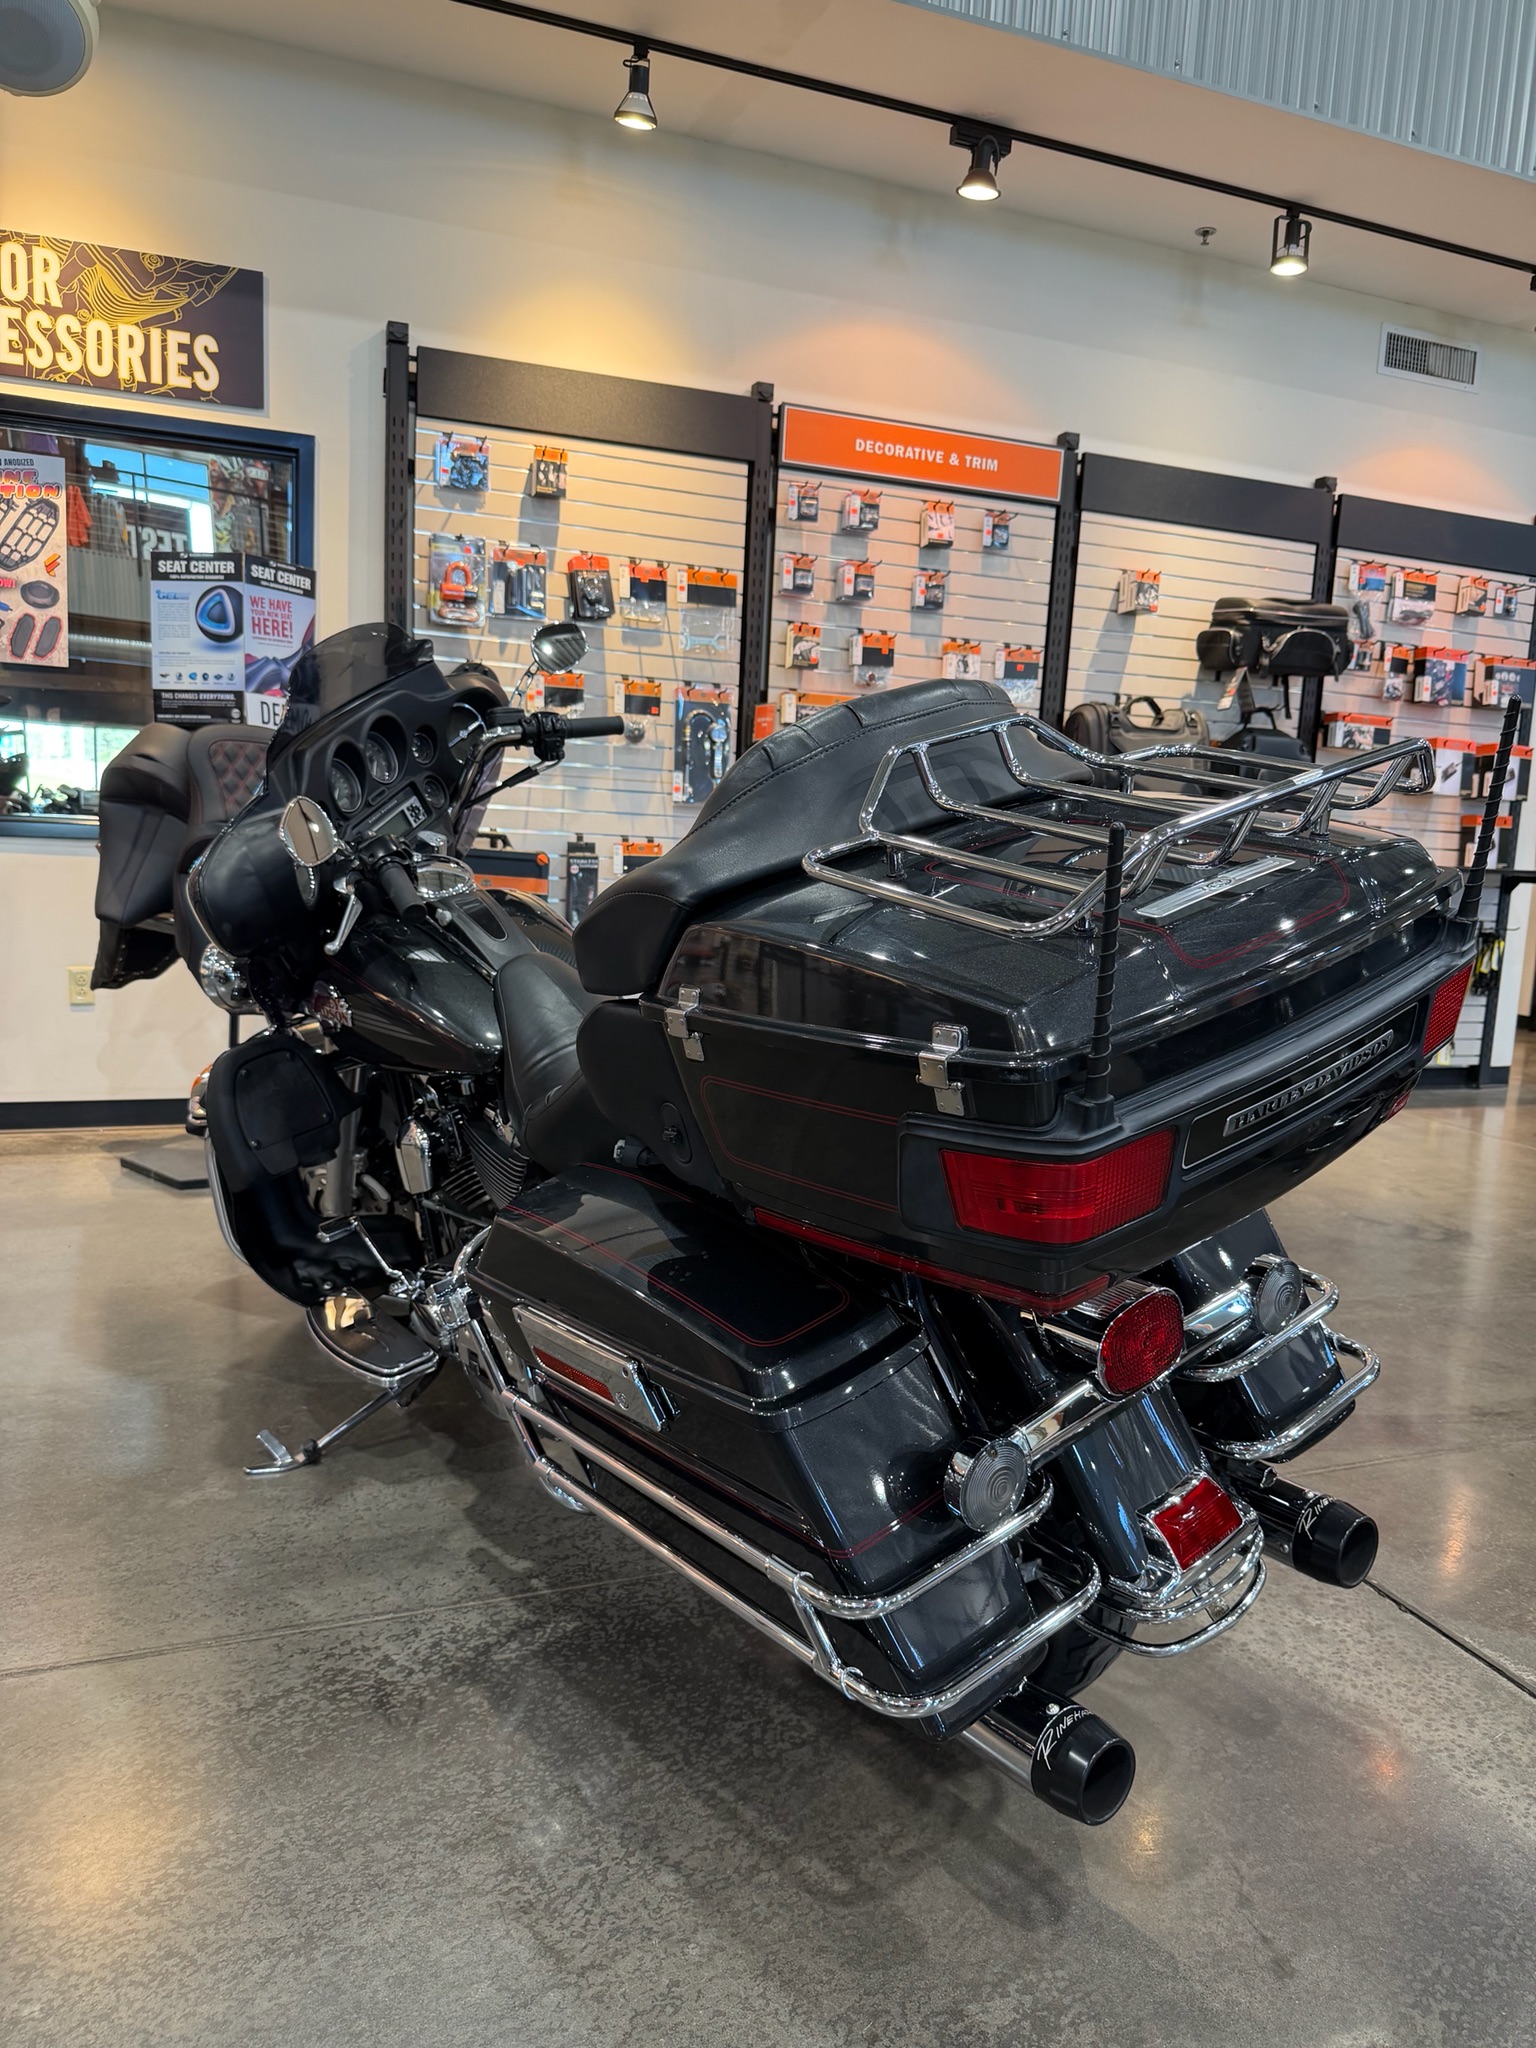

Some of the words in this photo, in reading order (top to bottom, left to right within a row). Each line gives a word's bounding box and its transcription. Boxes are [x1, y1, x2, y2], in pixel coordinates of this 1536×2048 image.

[0, 241, 63, 307] OR
[0, 305, 220, 393] ESSORIES
[4, 458, 34, 467] ANODIZED
[855, 438, 944, 464] DECORATIVE
[948, 452, 960, 467] &
[965, 454, 998, 472] TRIM
[157, 560, 187, 574] SEAT
[189, 560, 235, 574] CENTER
[250, 564, 276, 582] SEAT
[277, 571, 312, 591] CENTER
[249, 595, 266, 609] WE
[268, 598, 292, 613] HAVE
[251, 616, 294, 639] HERE!
[1233, 1034, 1393, 1131] HARLEY-DAVIDSON
